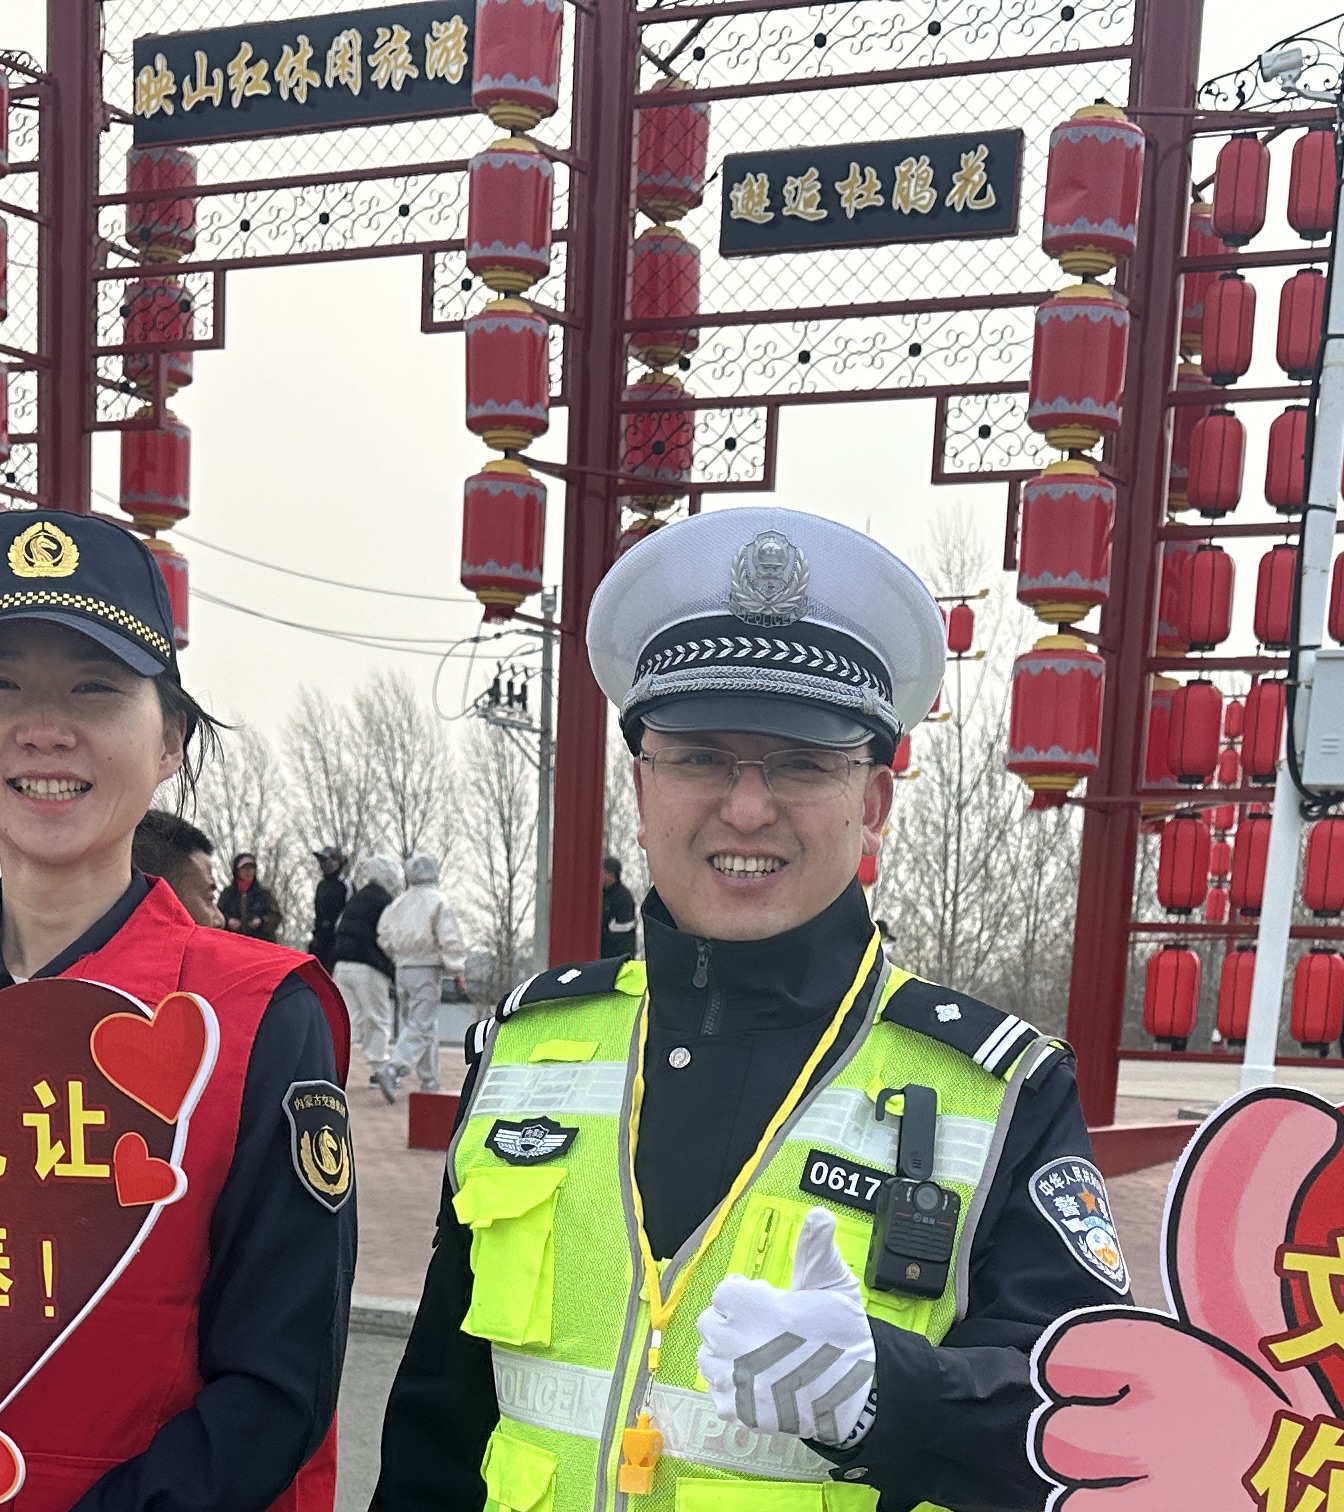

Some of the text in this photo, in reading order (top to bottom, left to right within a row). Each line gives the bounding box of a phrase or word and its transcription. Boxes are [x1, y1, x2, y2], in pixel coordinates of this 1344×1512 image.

[134, 14, 470, 119] 映山红休闲旅游
[729, 144, 996, 224] 邂逅杜鹃花
[746, 612, 790, 626] POLICE
[809, 1161, 882, 1202] 0617
